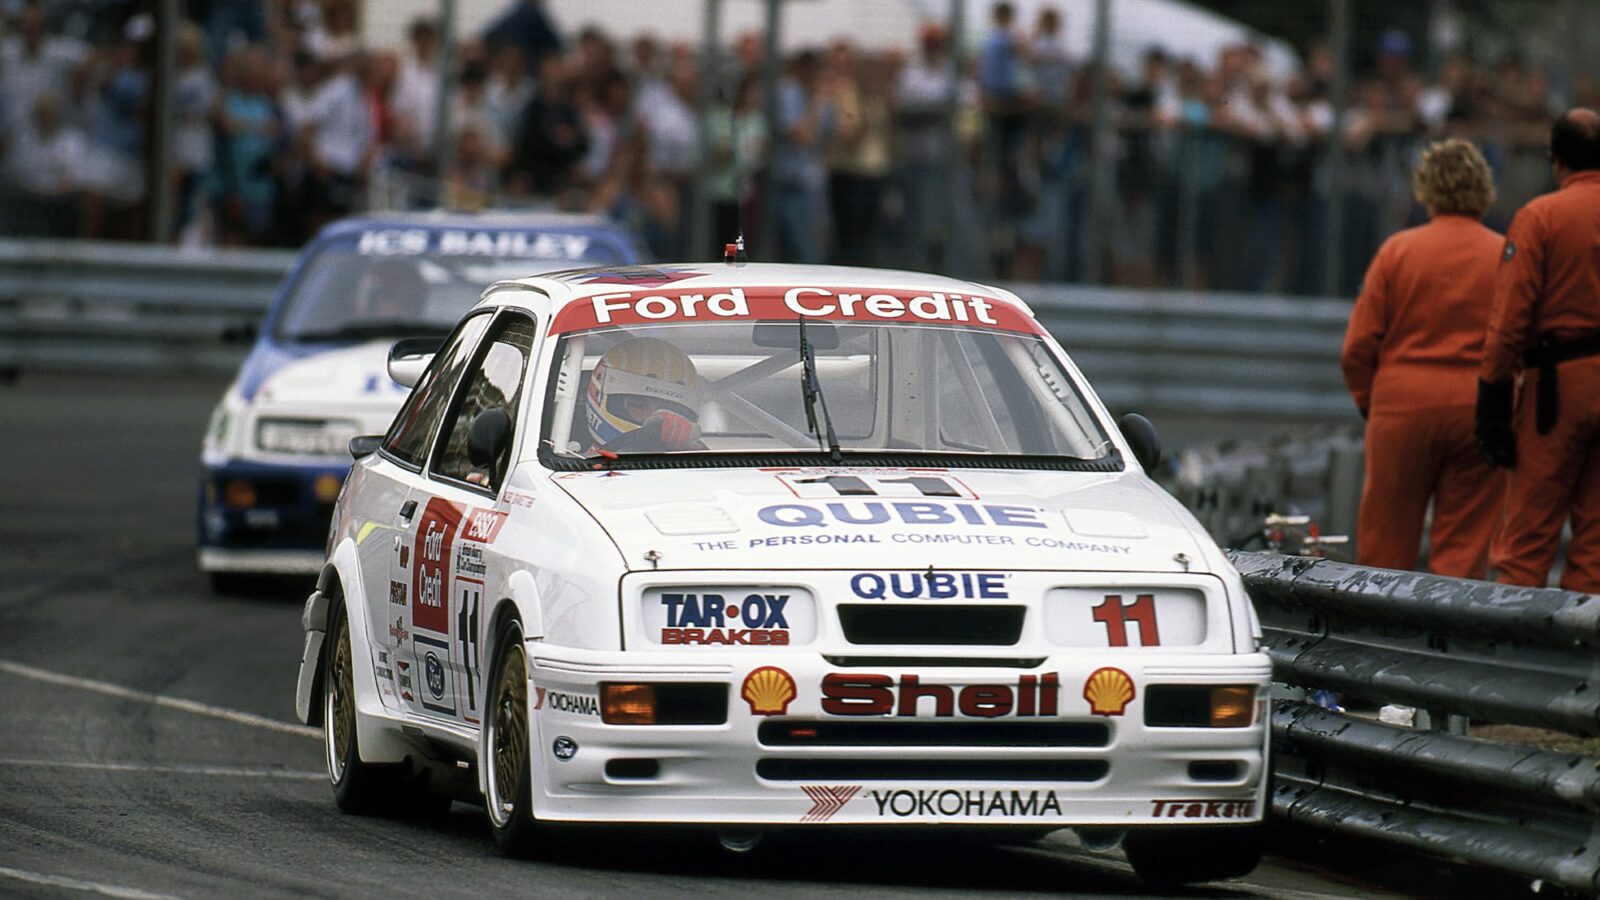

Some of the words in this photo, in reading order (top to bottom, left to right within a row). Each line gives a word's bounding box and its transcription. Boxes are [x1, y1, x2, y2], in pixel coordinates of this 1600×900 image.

[359, 231, 428, 255] ICS
[440, 230, 589, 258] BAILEY
[591, 288, 749, 323] Ford
[784, 287, 998, 325] Credit
[793, 475, 963, 498] 11
[468, 511, 496, 539] ESSO
[423, 520, 447, 562] Ford
[692, 538, 738, 552] THE
[749, 534, 881, 546] PERSONAL
[892, 534, 1015, 546] COMPUTER
[1025, 537, 1132, 556] COMPANY
[418, 563, 443, 609] Credit
[1092, 595, 1160, 646] 11
[459, 589, 482, 711] 11
[661, 628, 790, 645] BRAKES
[547, 692, 600, 716] YOKOHAMA
[821, 674, 1058, 718] Shell
[873, 790, 1062, 817] YOKOHAMA
